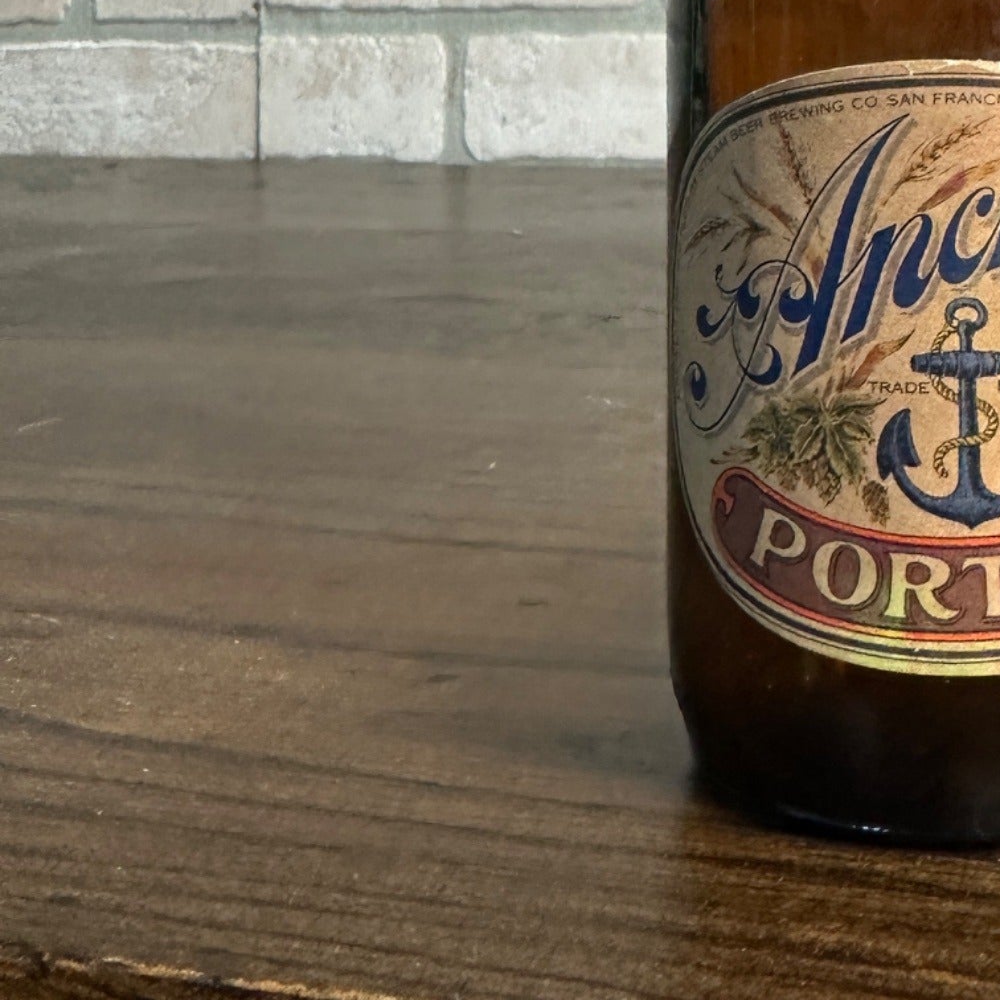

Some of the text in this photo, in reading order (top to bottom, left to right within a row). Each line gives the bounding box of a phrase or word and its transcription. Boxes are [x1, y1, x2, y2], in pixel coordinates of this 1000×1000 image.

[731, 118, 764, 142] BEER
[769, 100, 845, 126] BREWING
[887, 93, 925, 106] SAN
[868, 380, 931, 395] TRADE
